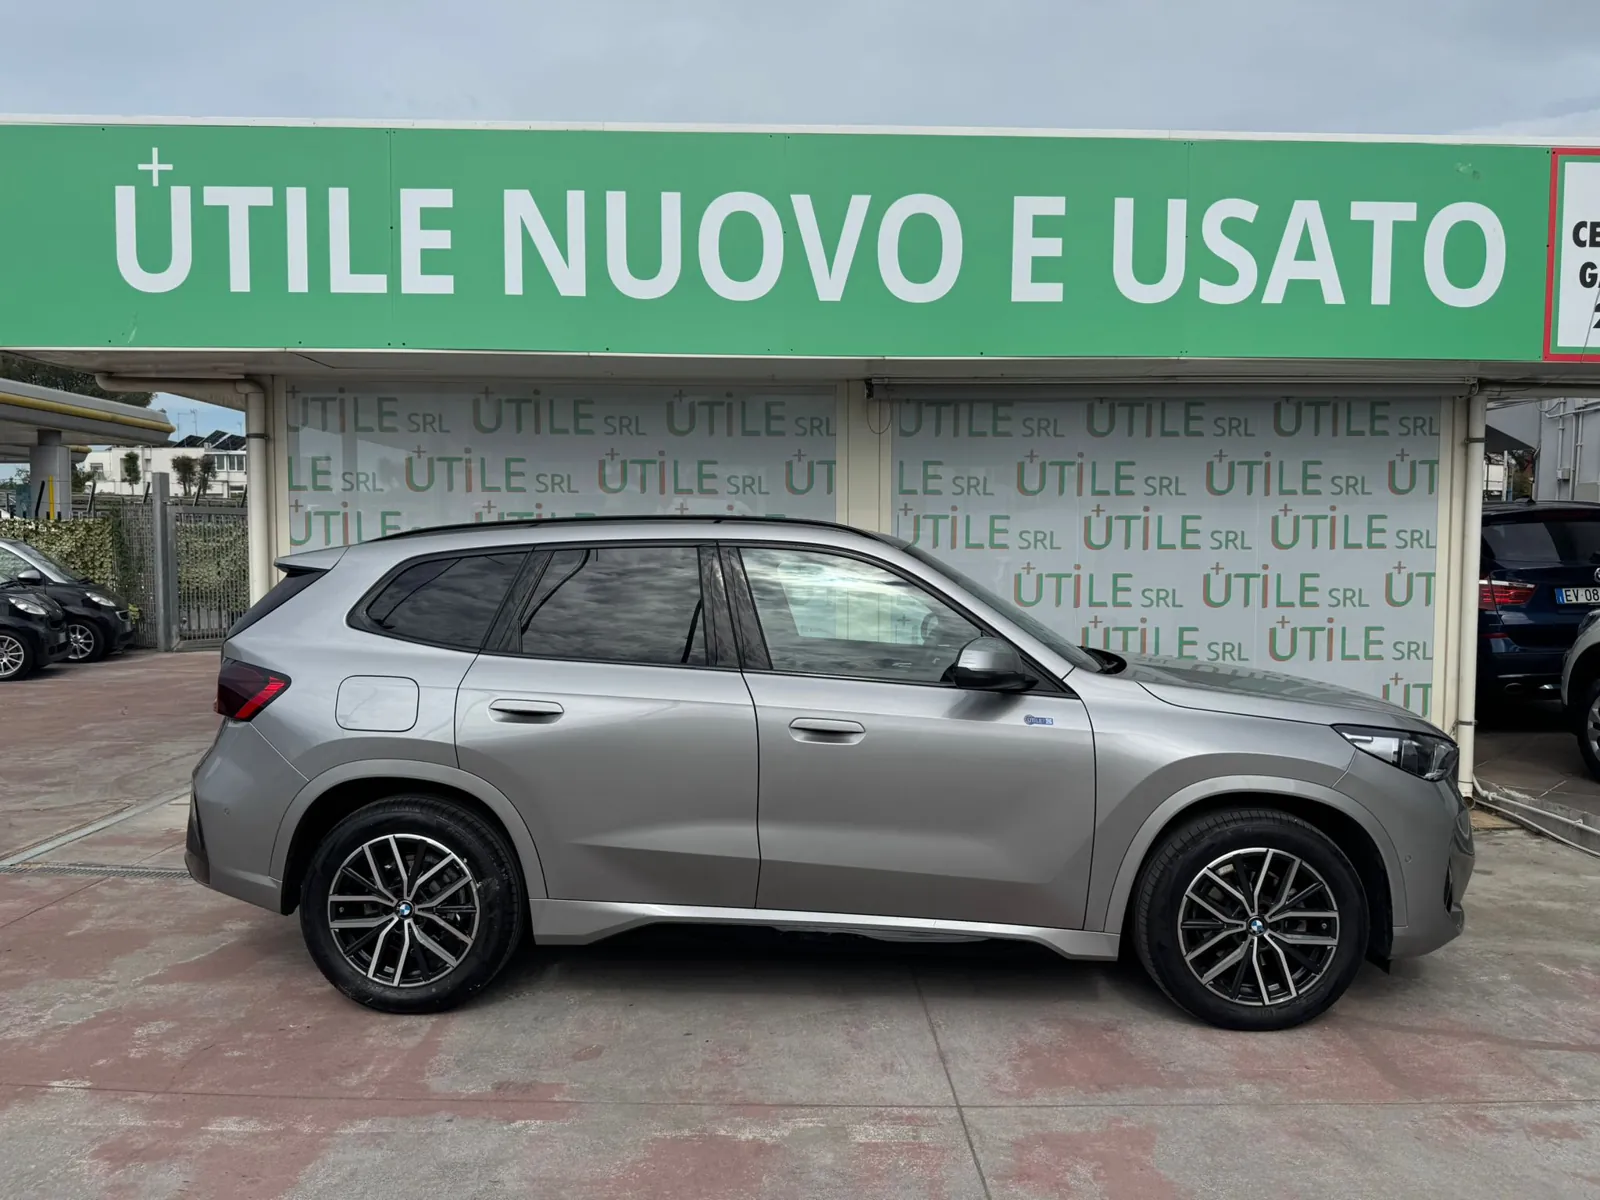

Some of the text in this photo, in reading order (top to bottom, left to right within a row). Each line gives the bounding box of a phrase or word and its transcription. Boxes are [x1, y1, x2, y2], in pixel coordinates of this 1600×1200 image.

[115, 185, 1506, 307] UTILE NUOVO E USATO
[407, 413, 450, 433] SRL
[604, 415, 647, 436] SRL
[794, 417, 836, 437] SRL
[1022, 417, 1065, 438] SRL
[1213, 417, 1256, 437] SRL
[1398, 416, 1440, 436] SRL
[341, 472, 384, 492] SRL
[535, 474, 579, 493] SRL
[727, 475, 770, 495] SRL
[952, 476, 994, 496] SRL
[1144, 476, 1187, 496] SRL
[1330, 475, 1372, 495] SRL
[1018, 530, 1061, 550] SRL
[1210, 530, 1252, 550] SRL
[1395, 530, 1436, 549] SRL
[1140, 588, 1184, 608] SRL
[1328, 588, 1370, 608] SRL
[1206, 642, 1249, 662] SRL
[1392, 641, 1433, 661] SRL
